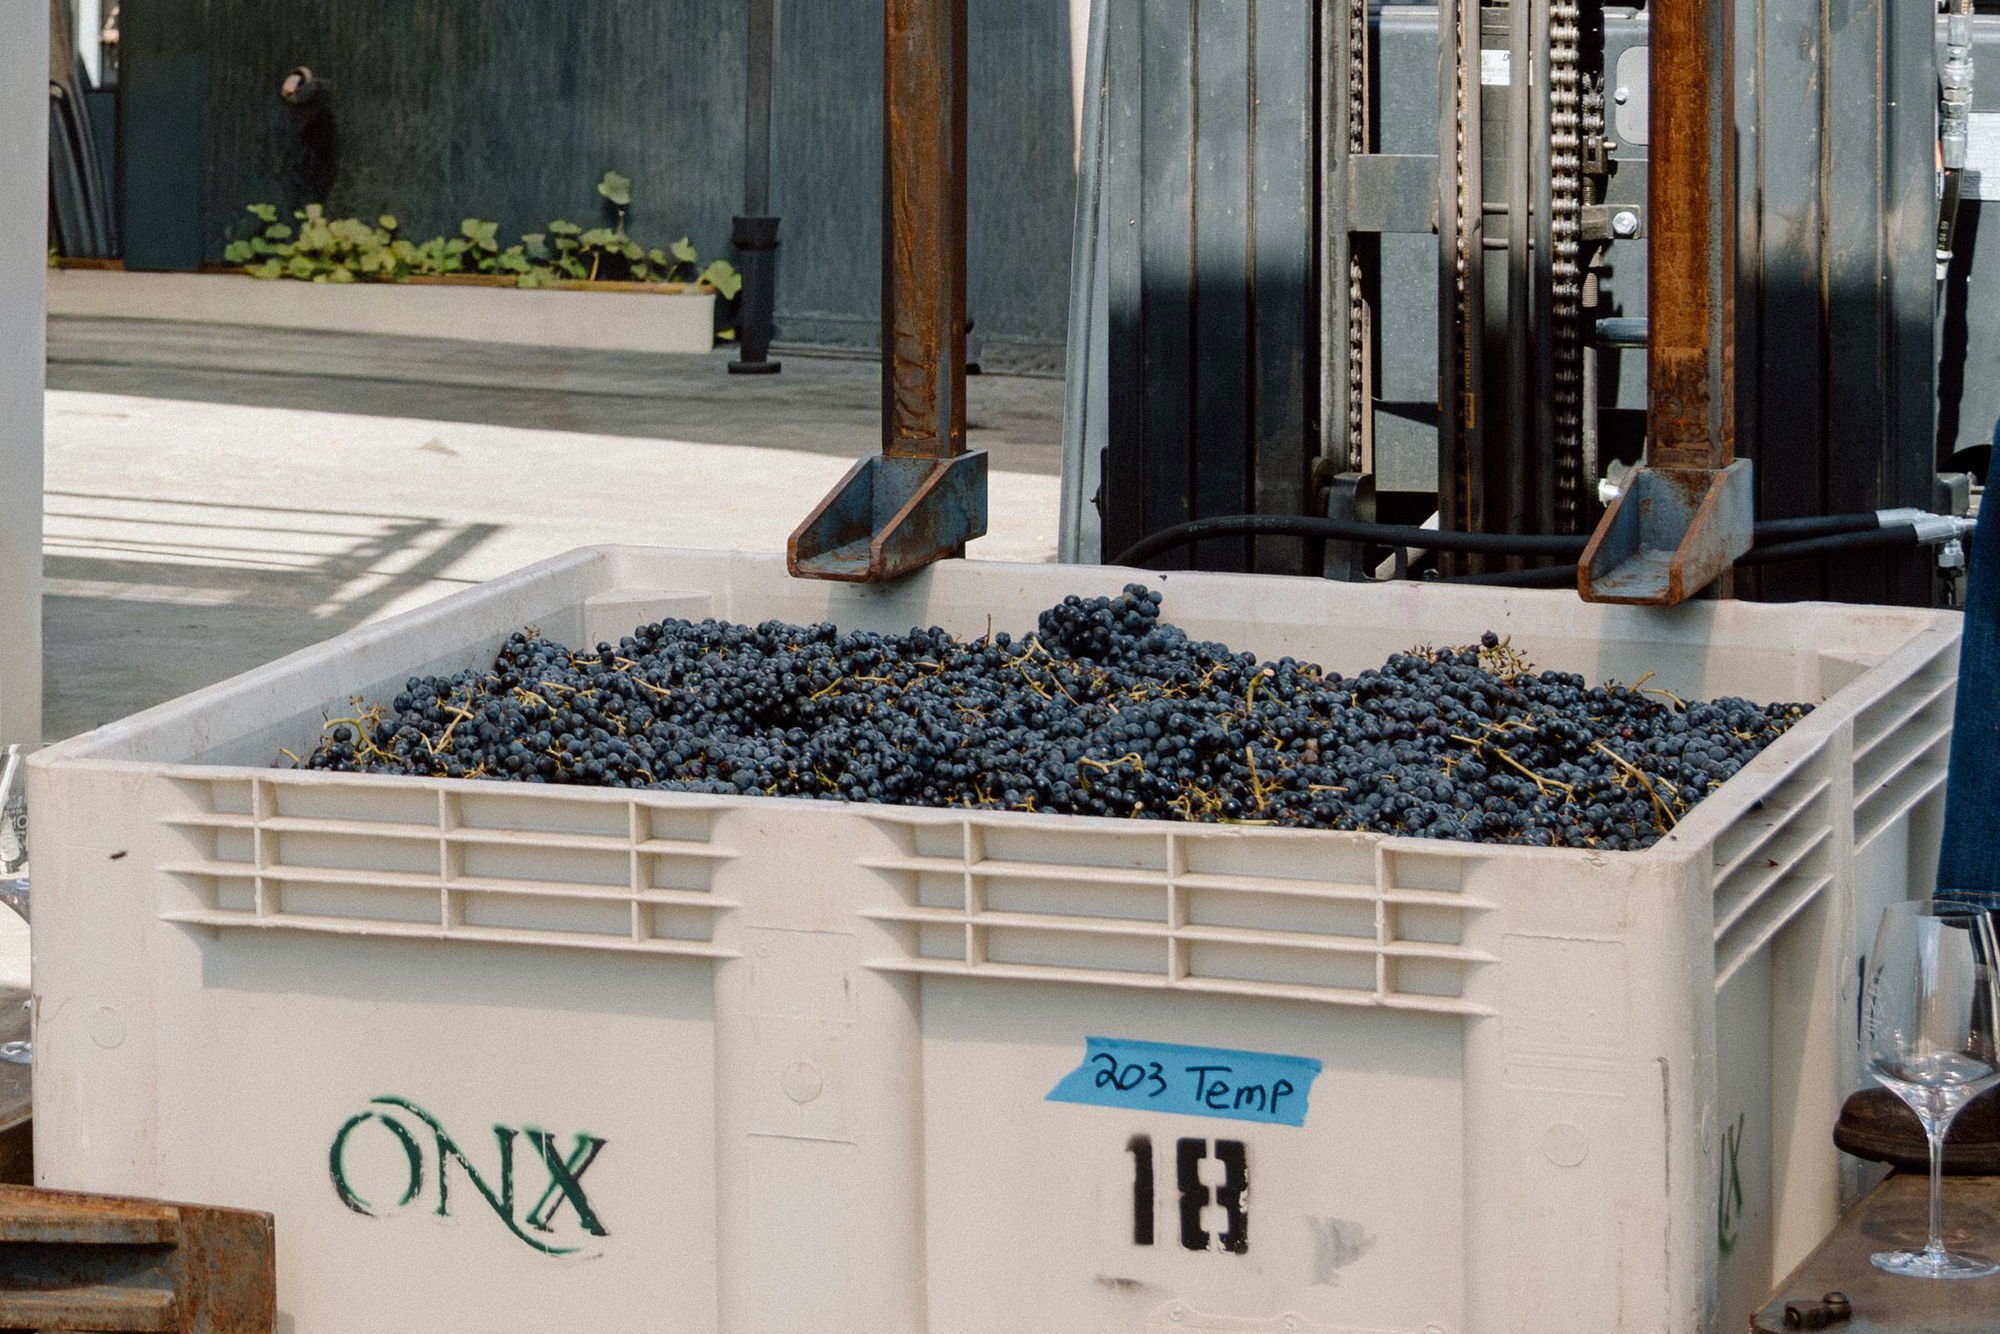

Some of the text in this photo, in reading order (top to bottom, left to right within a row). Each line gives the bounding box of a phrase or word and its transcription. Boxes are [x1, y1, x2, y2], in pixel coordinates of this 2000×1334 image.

[1091, 1053, 1293, 1113] 203 Temp
[329, 1096, 610, 1255] ONX
[1126, 1133, 1249, 1255] 18
